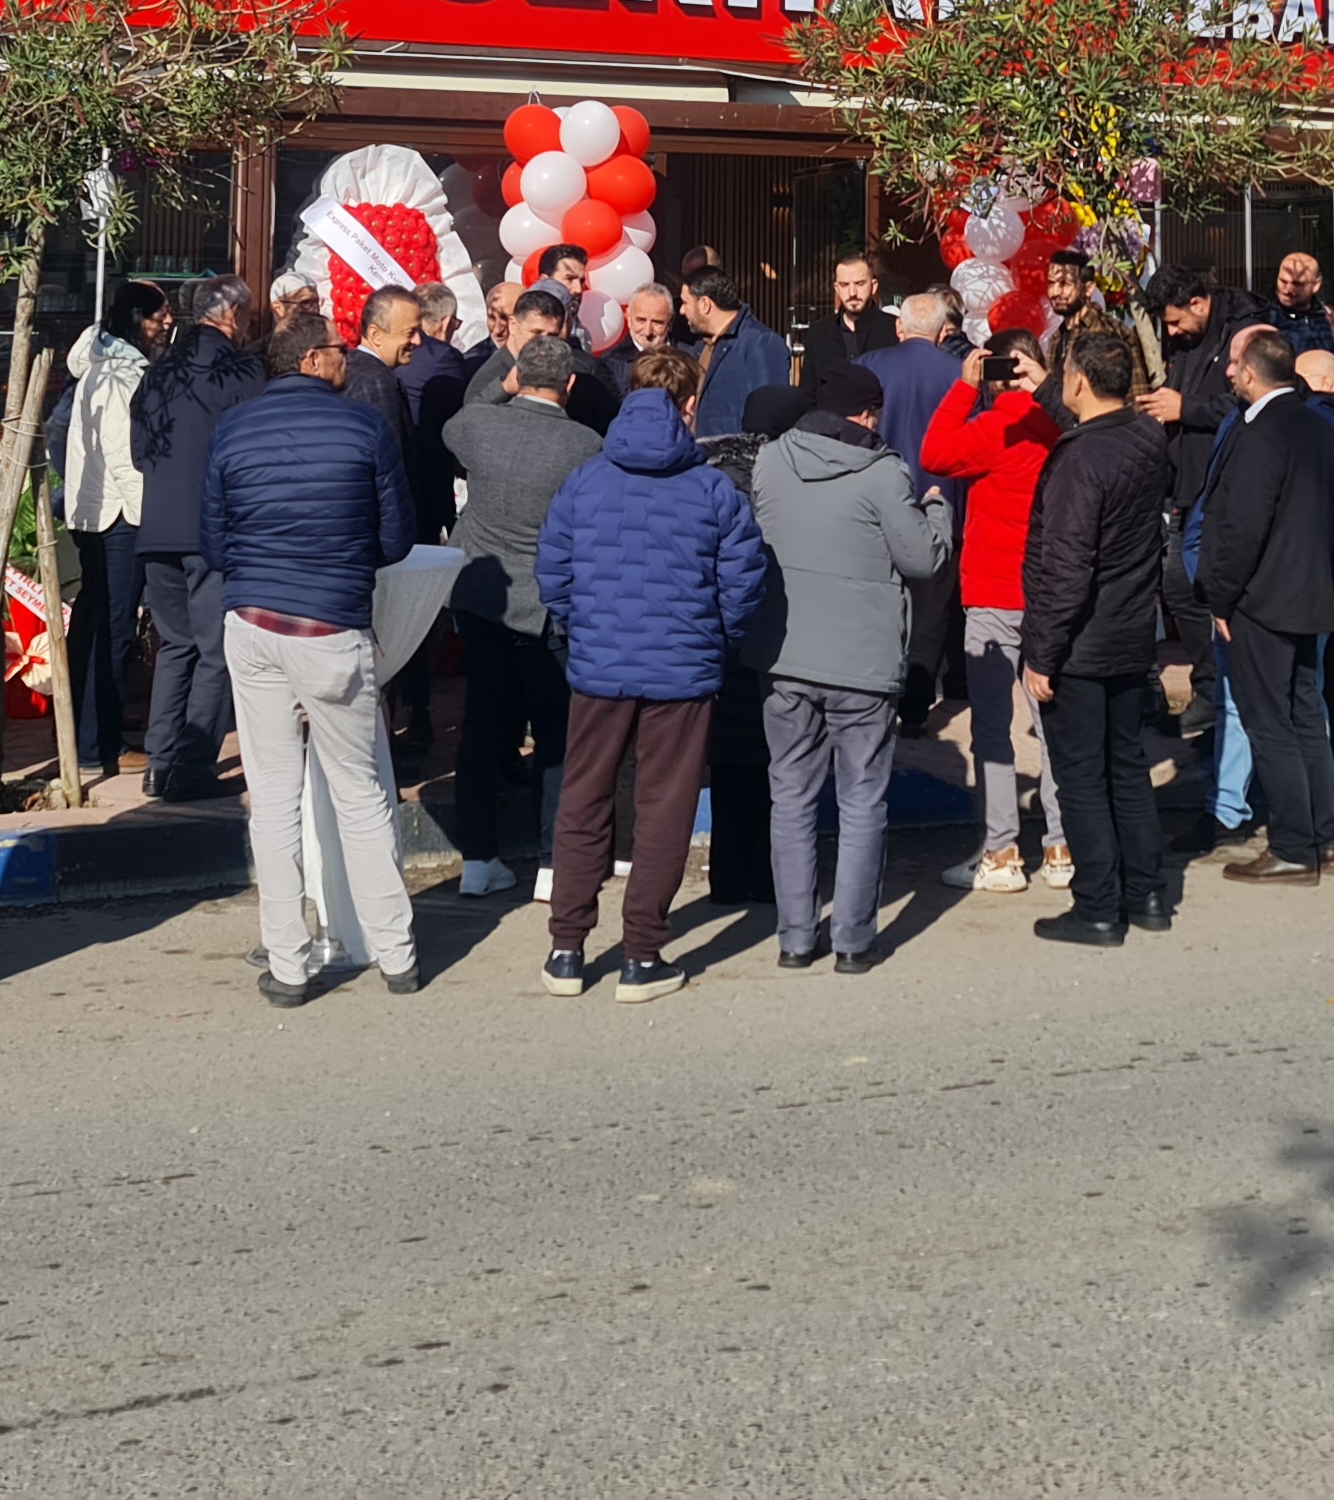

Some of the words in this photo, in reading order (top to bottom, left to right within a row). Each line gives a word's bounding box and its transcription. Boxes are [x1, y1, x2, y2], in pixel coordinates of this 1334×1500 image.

[326, 210, 351, 236] Express
[352, 232, 372, 255] Paket
[370, 252, 388, 272] Moto
